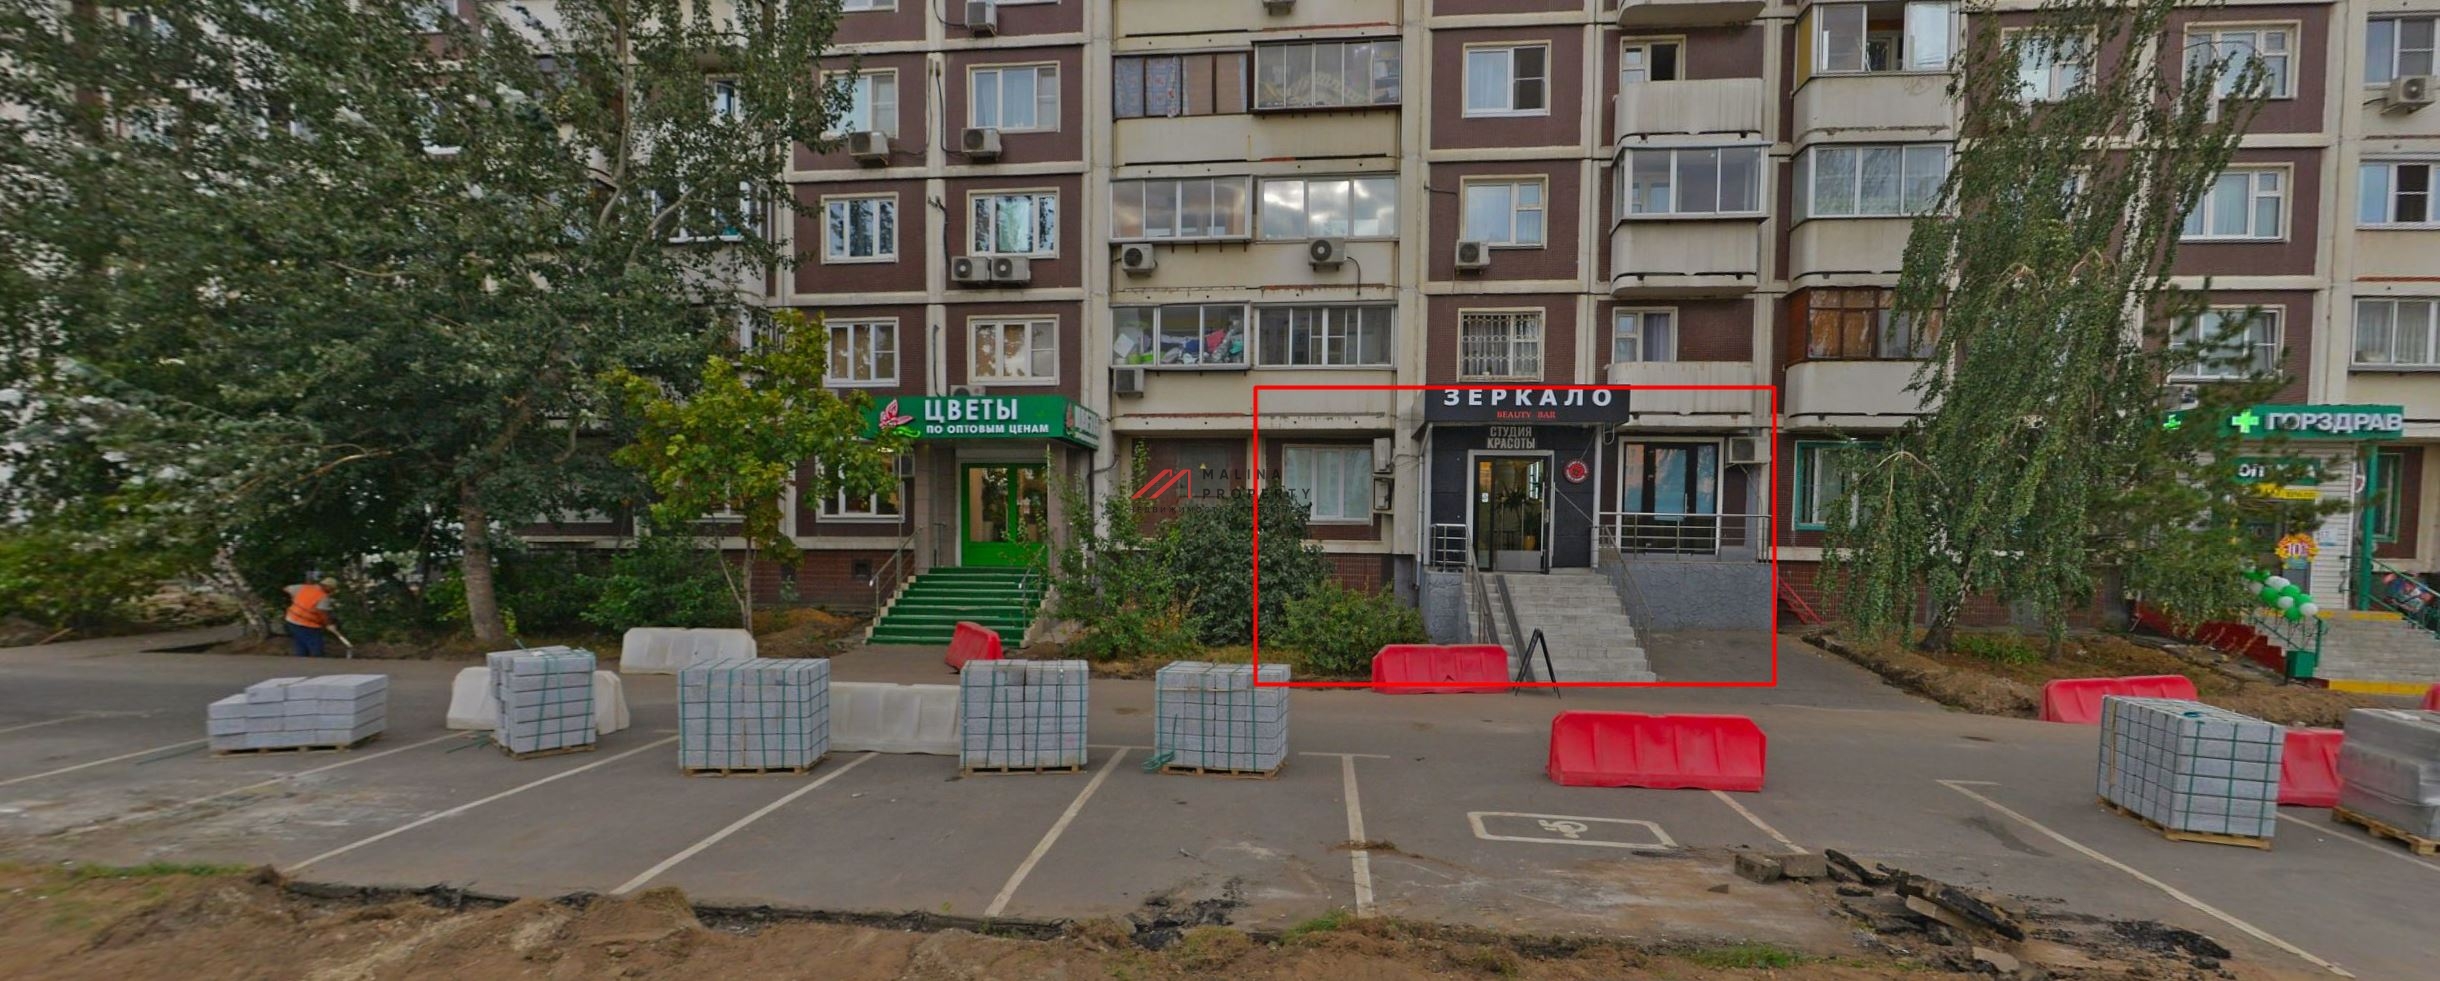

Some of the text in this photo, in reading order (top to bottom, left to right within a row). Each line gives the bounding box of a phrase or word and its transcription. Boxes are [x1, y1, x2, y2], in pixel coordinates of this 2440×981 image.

[1443, 388, 1612, 406] ЗЕРКАЛО
[924, 398, 1018, 423] ЦВЕТЫ
[1496, 410, 1556, 419] BEAUTY BAR
[2265, 412, 2402, 434] ГОРЗДРАВ
[926, 424, 1049, 435] ПО ОПТОВЫМ ЦЕНАМ
[1489, 426, 1533, 438] СТУДИЯ
[1487, 438, 1536, 449] КРАСОТЫ
